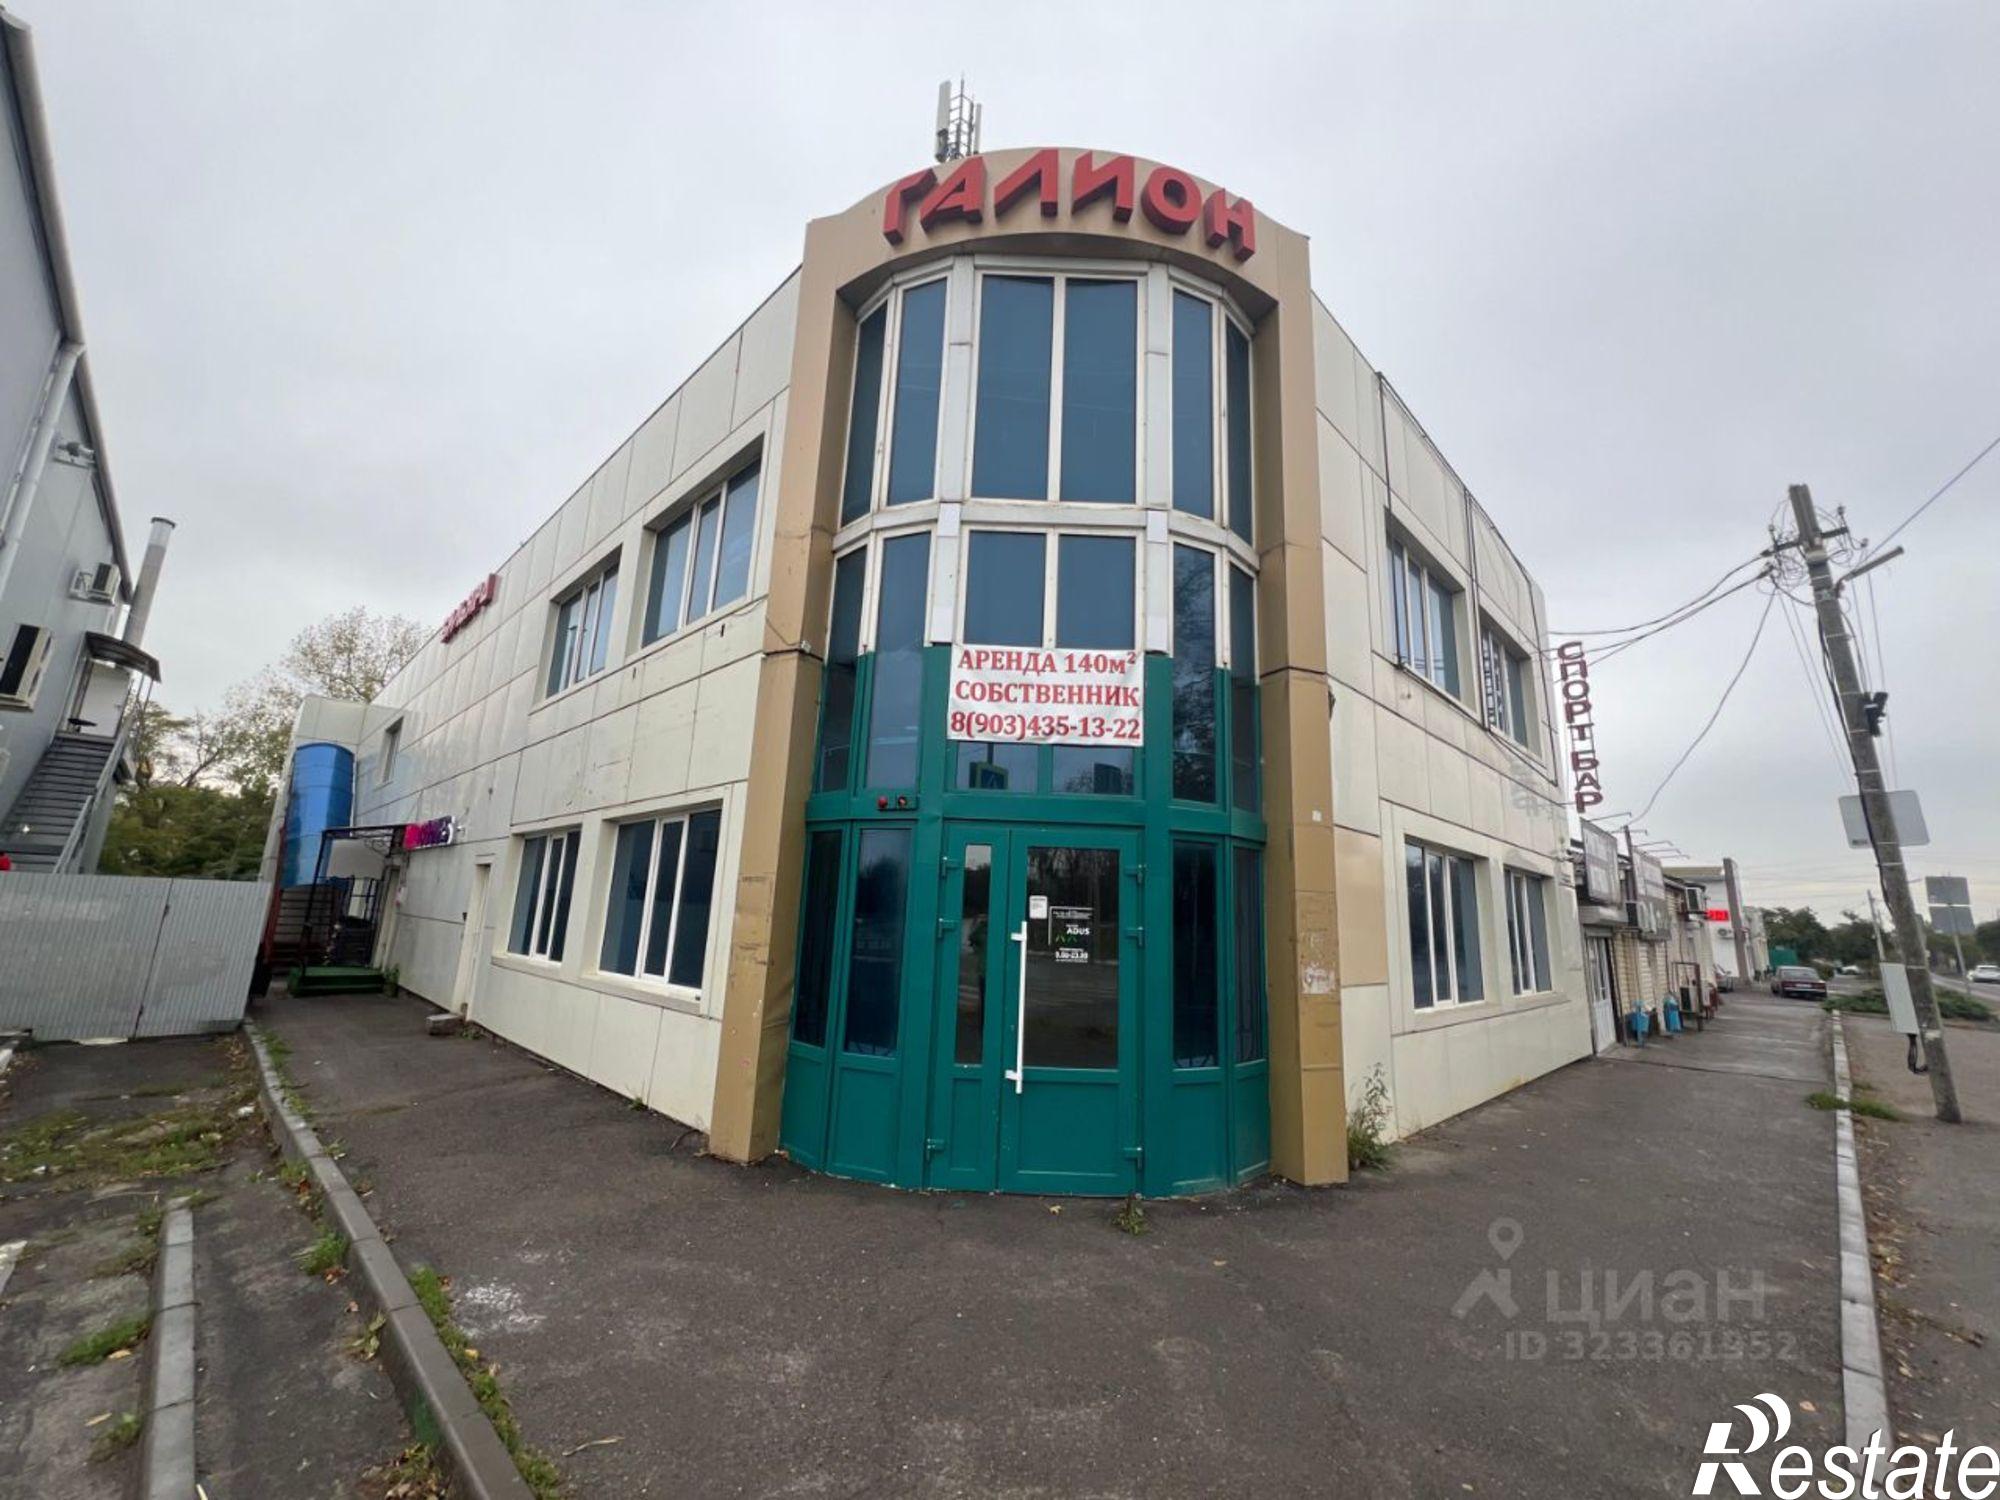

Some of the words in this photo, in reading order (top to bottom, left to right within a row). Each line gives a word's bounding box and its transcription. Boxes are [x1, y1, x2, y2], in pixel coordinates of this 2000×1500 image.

[883, 147, 1256, 262] ГАЛИОН
[957, 649, 1057, 676] АРЕНДА
[955, 680, 1139, 707] СОБСТВЕННИК
[951, 711, 1141, 741] 8(903)435-13-22
